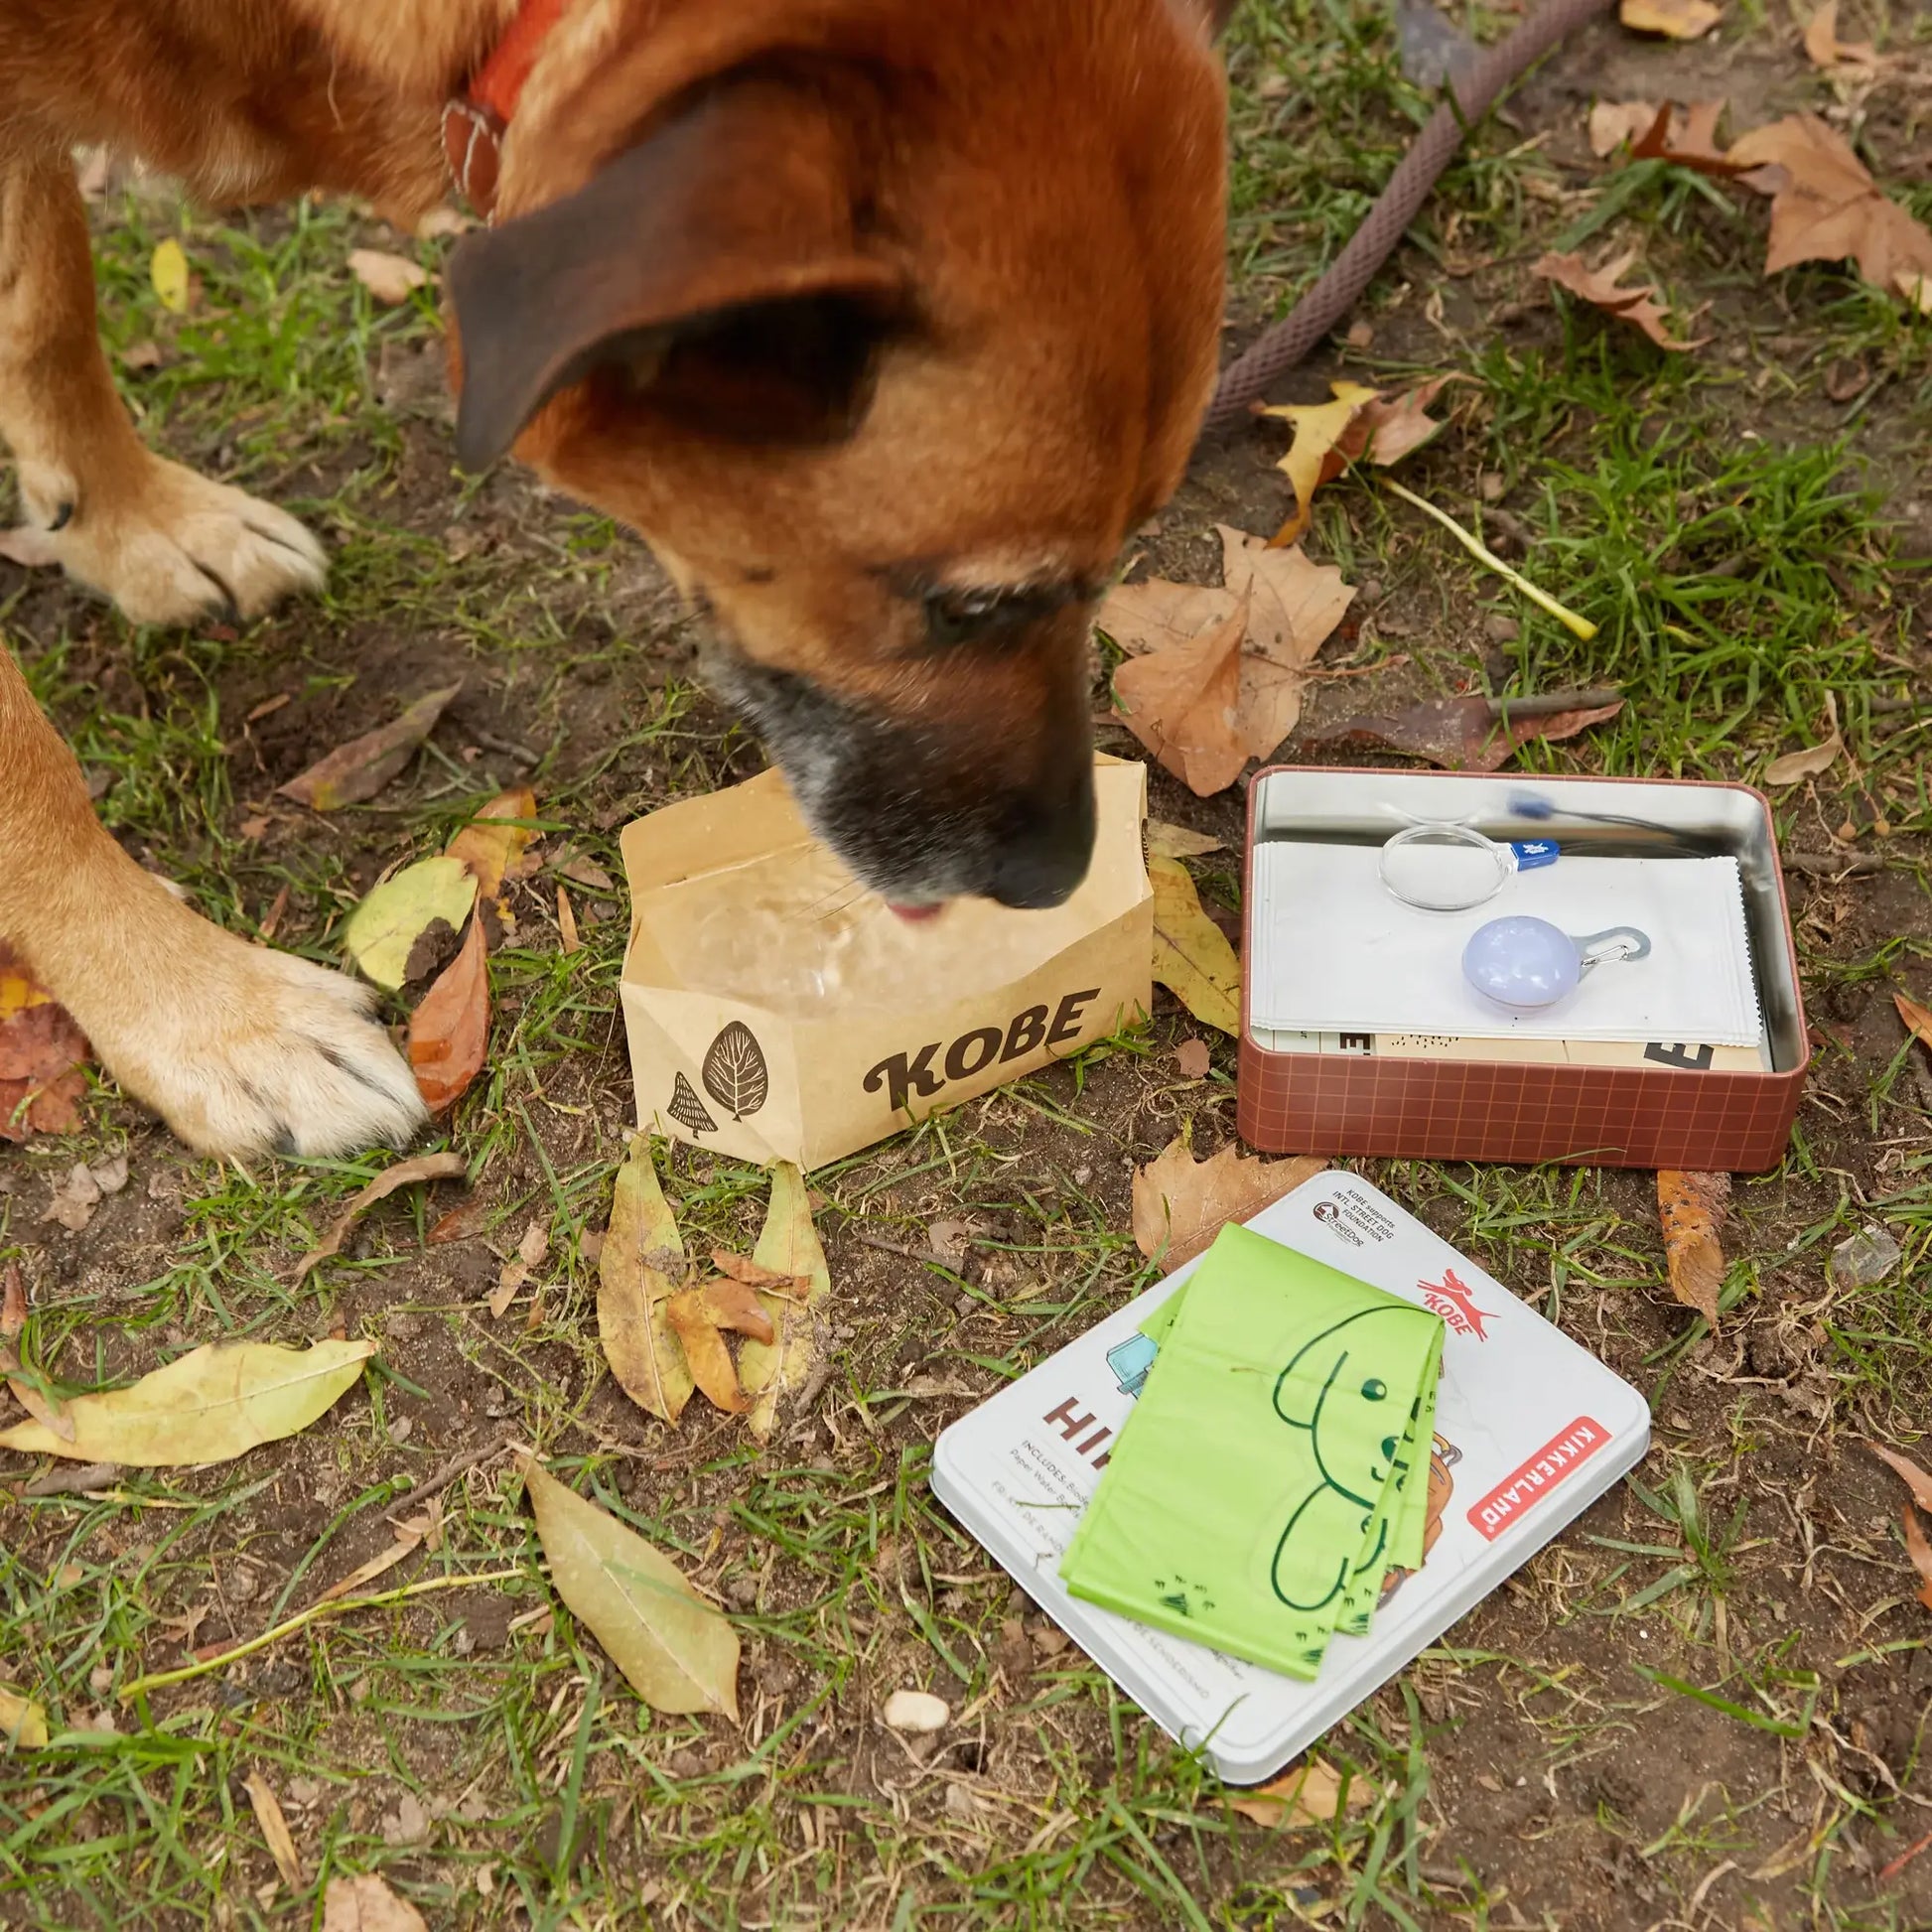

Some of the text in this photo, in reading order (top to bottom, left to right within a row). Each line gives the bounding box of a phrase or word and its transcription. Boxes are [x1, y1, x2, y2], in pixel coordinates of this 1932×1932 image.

[863, 988, 1101, 1112] KOBE
[1341, 1208, 1385, 1243] FOUNDATION
[1346, 1188, 1396, 1229] KOBE supports
[1350, 1204, 1379, 1227] STREET
[1376, 1224, 1395, 1240] DOG
[1425, 1293, 1473, 1336] KOBE
[1480, 1426, 1597, 1528] KIKKERLAND
